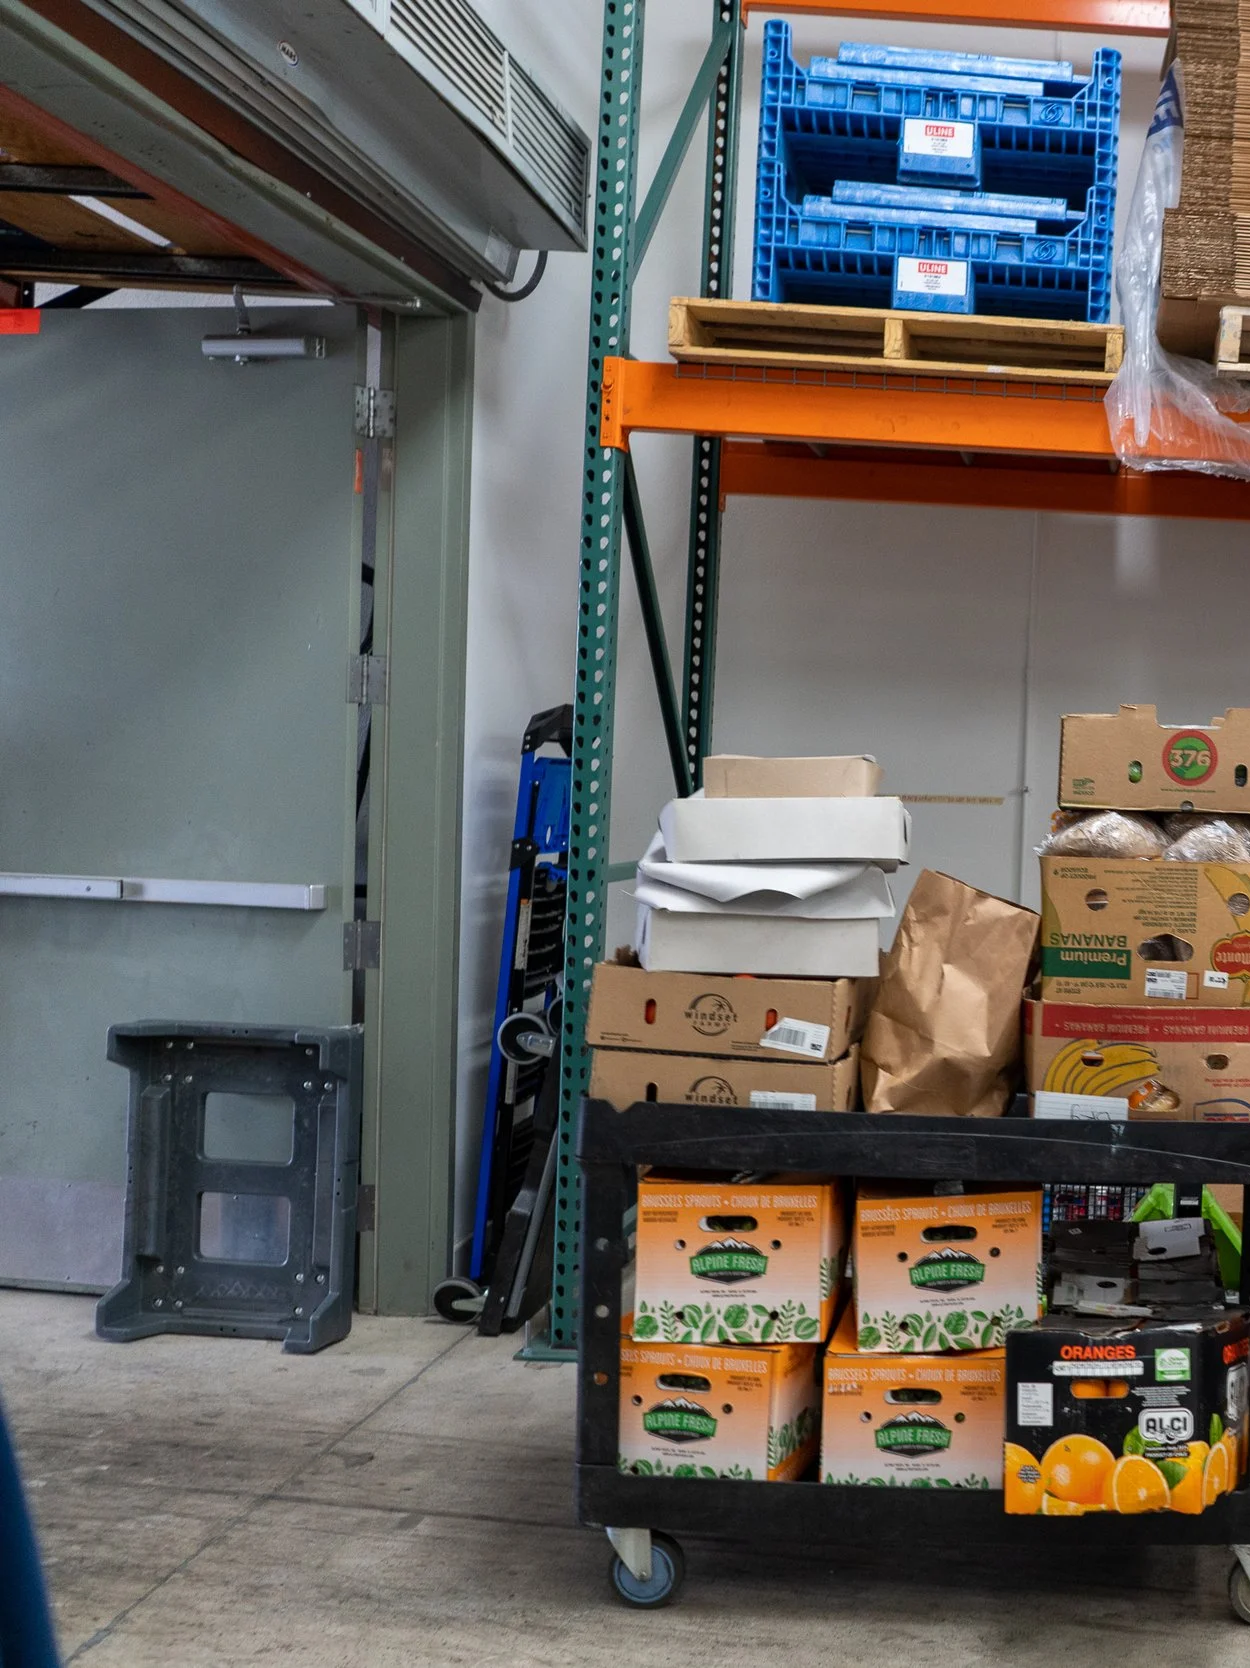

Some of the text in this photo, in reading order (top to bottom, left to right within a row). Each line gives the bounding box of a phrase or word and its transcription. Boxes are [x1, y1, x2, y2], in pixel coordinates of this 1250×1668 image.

[926, 126, 954, 137] ULINE
[919, 262, 947, 274] ULINE
[1170, 749, 1212, 768] 376
[1049, 932, 1128, 948] BANANAS
[1059, 950, 1128, 966] Premium
[684, 1011, 738, 1023] windset
[685, 1093, 738, 1105] windset
[641, 1194, 817, 1209] BRUSSELS SPROUTS CHOUX DE BRUXELLES
[860, 1200, 1032, 1222] BRUSSELS SPROUTS CHOUX DE BRUXELLES
[692, 1255, 766, 1272] ALPINE FRESH
[912, 1264, 983, 1282] ALPINE FRESH
[1060, 1344, 1137, 1360] ORANGES
[711, 1356, 723, 1370] DE
[828, 1368, 1001, 1382] BRUSSELS SPROUTS CHOUX DE BRUXELLES
[645, 1414, 715, 1433] ALPINE FRESH
[1146, 1417, 1187, 1432] ALCI
[877, 1429, 950, 1445] ALPINE FRESH
